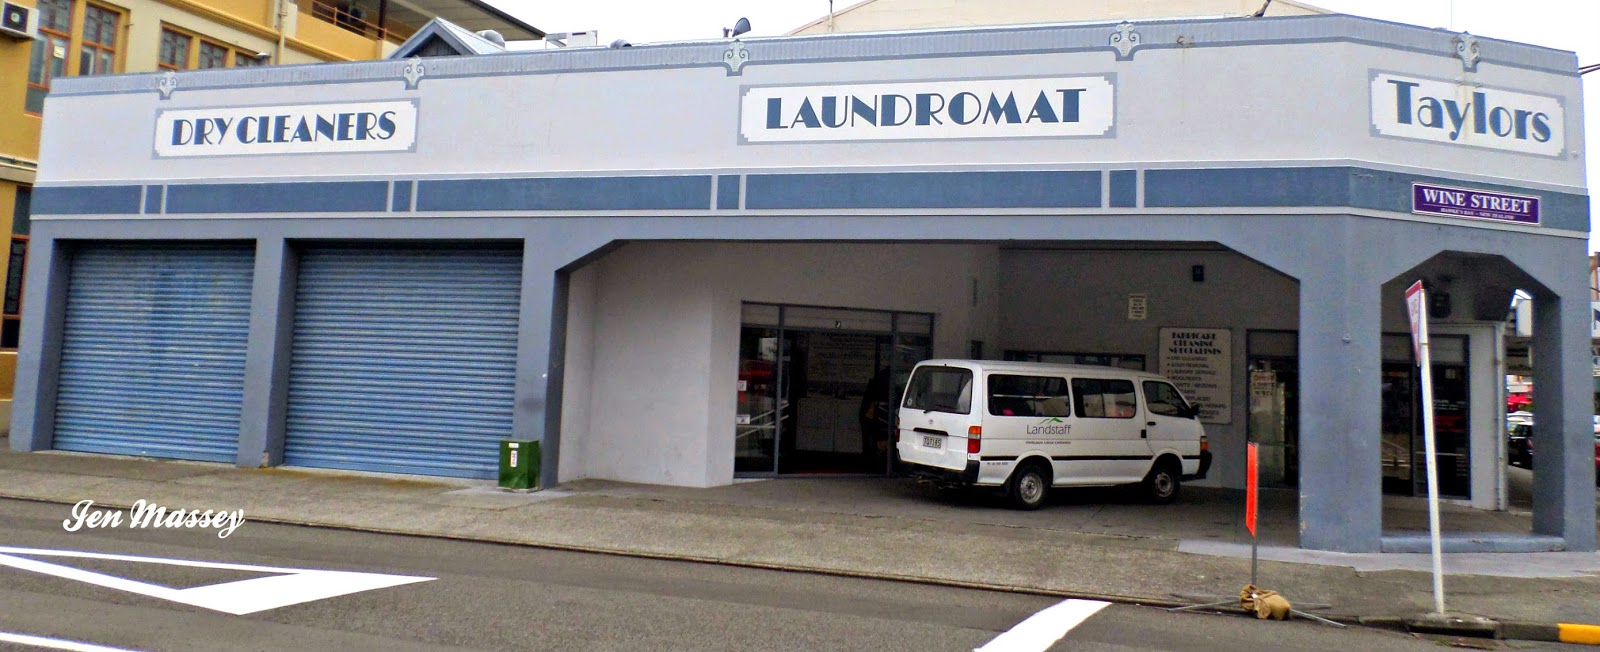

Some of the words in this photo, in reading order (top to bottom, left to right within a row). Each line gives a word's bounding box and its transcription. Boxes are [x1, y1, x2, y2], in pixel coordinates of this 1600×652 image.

[766, 88, 1087, 130] LAUNDROMAT
[1387, 79, 1551, 143] Taylors
[171, 116, 233, 146] DRY
[236, 110, 397, 144] CLEANERS
[1423, 188, 1466, 207] WINE
[1470, 194, 1531, 214] STREET
[1168, 347, 1222, 355] SPECIALISTS
[1026, 424, 1072, 435] Landstaff
